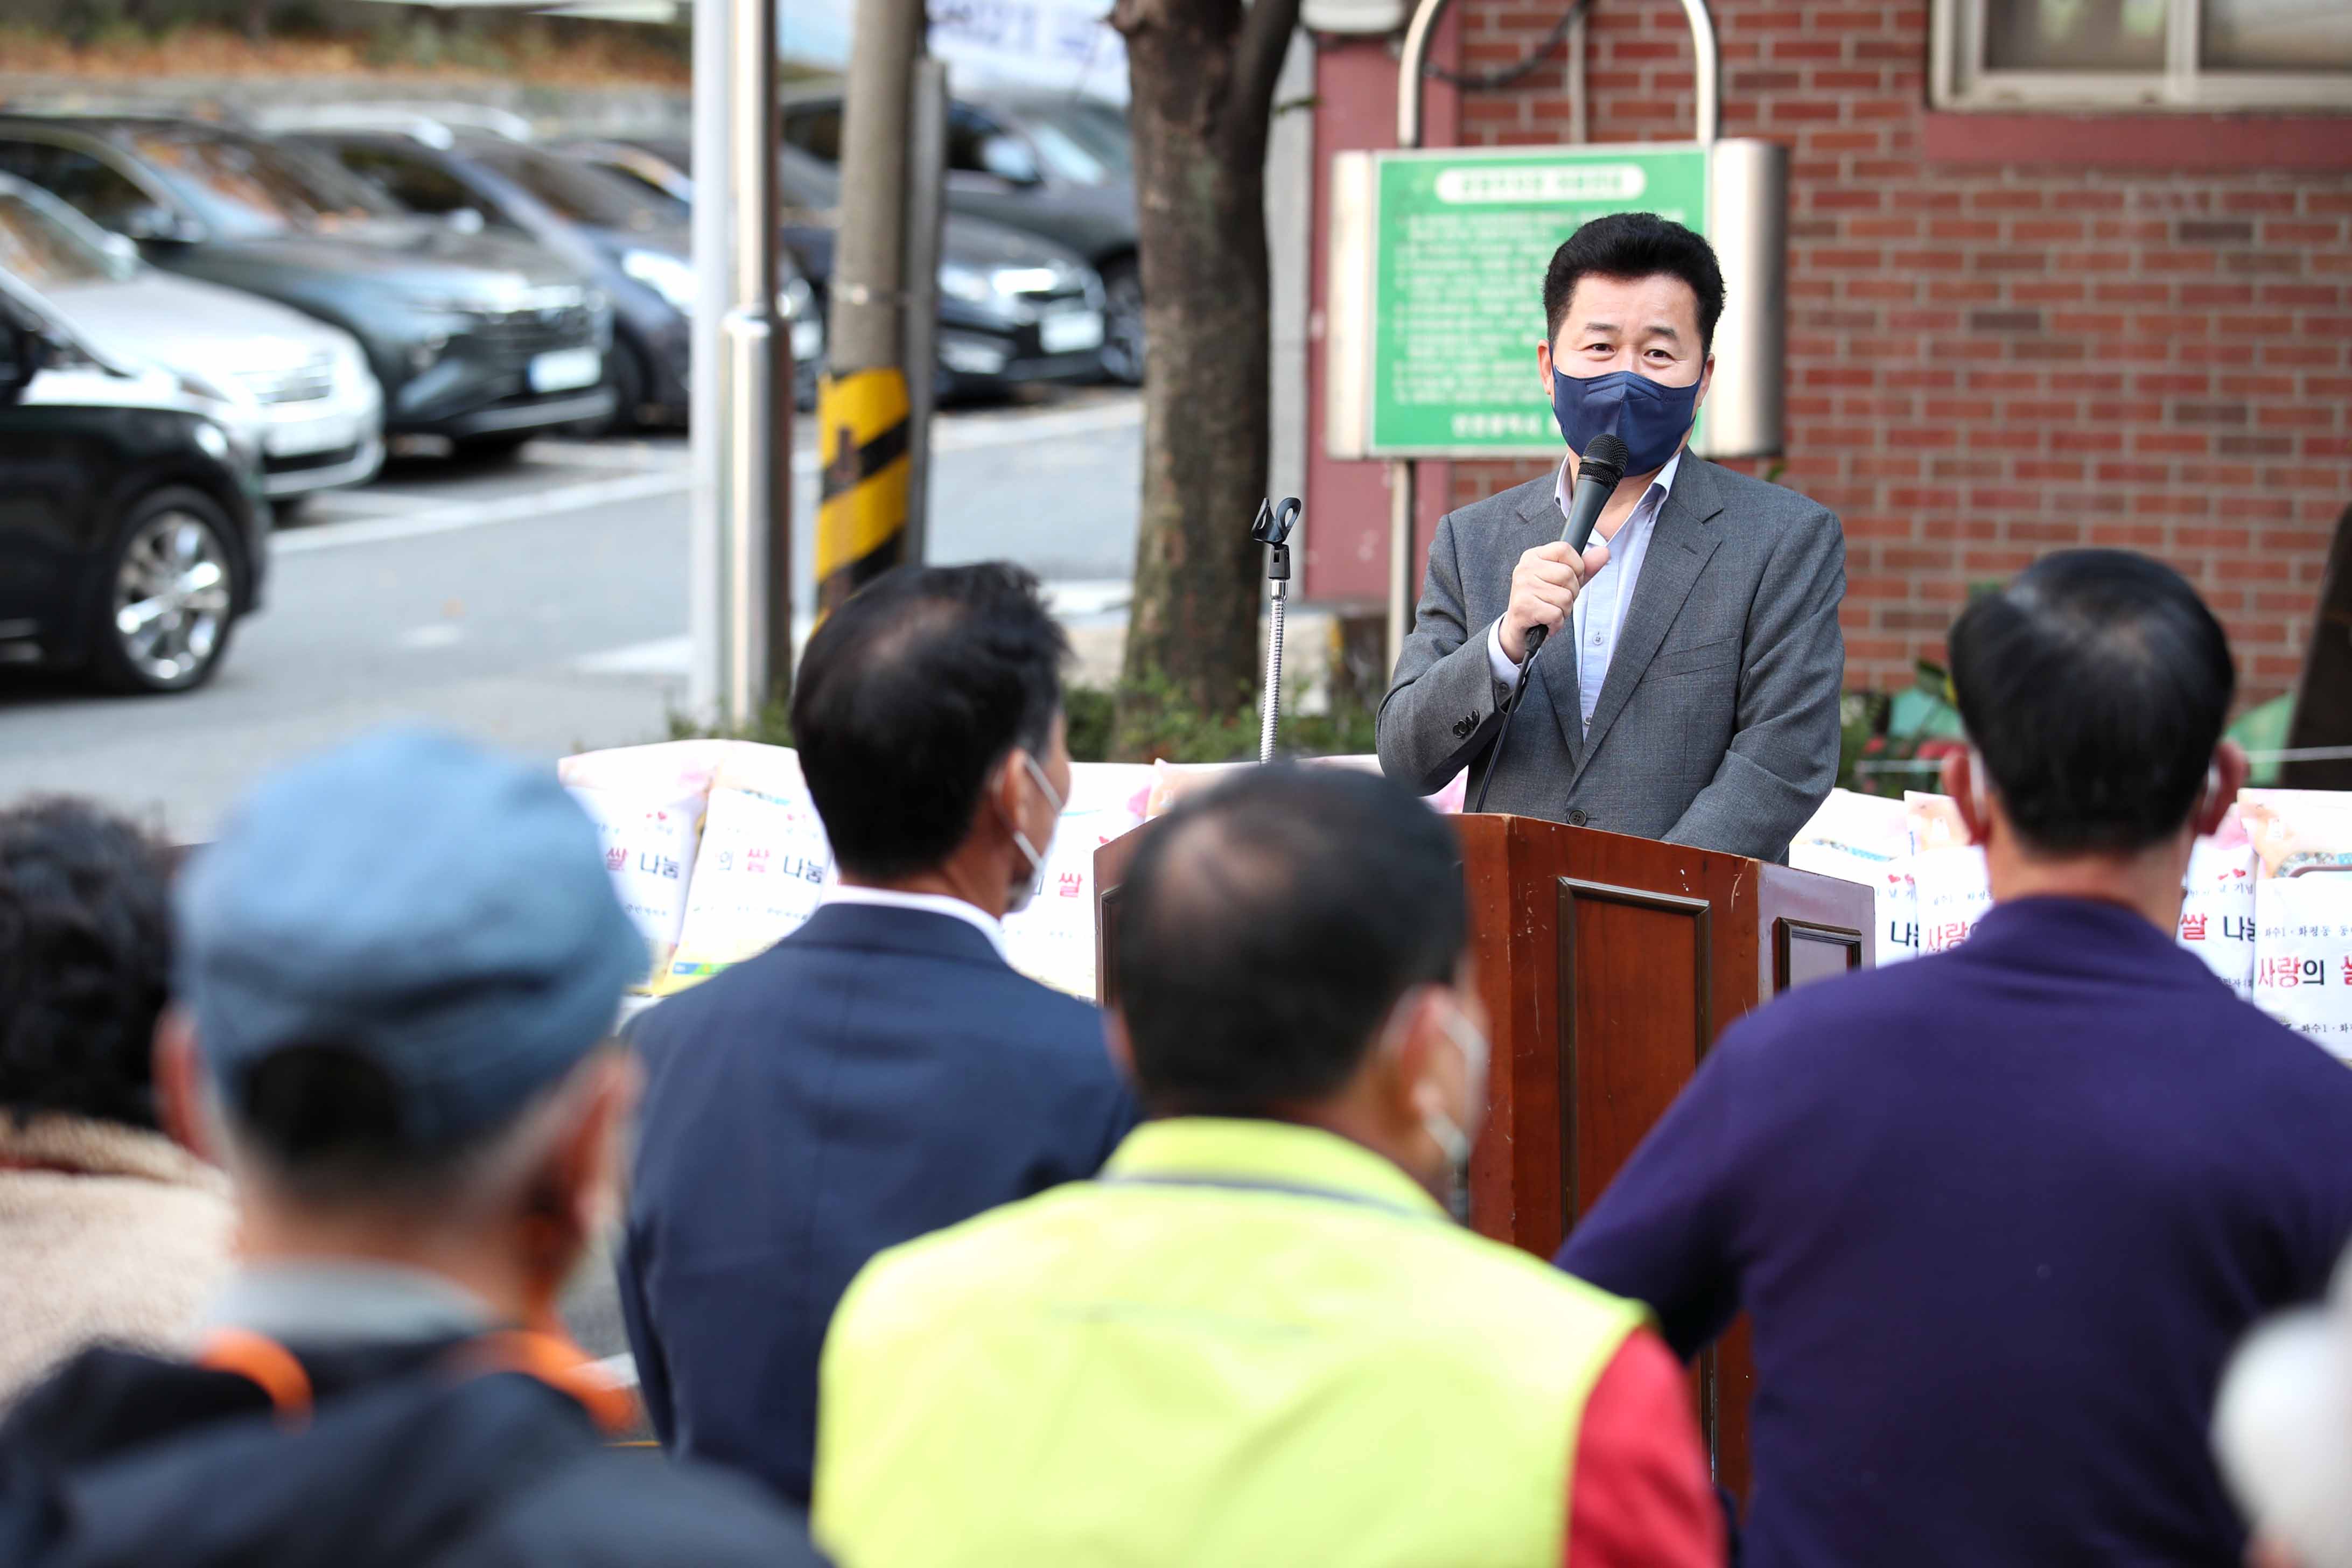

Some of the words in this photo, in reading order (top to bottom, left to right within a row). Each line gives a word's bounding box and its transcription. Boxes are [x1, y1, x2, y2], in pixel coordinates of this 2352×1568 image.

[640, 852, 679, 879] 나눔
[783, 855, 823, 883] 나눔
[1059, 872, 1082, 898] 쌀
[1891, 920, 1919, 948] 나
[1925, 921, 1978, 953] 사랑
[2181, 913, 2208, 940] 쌀
[2258, 956, 2325, 988] 사랑의
